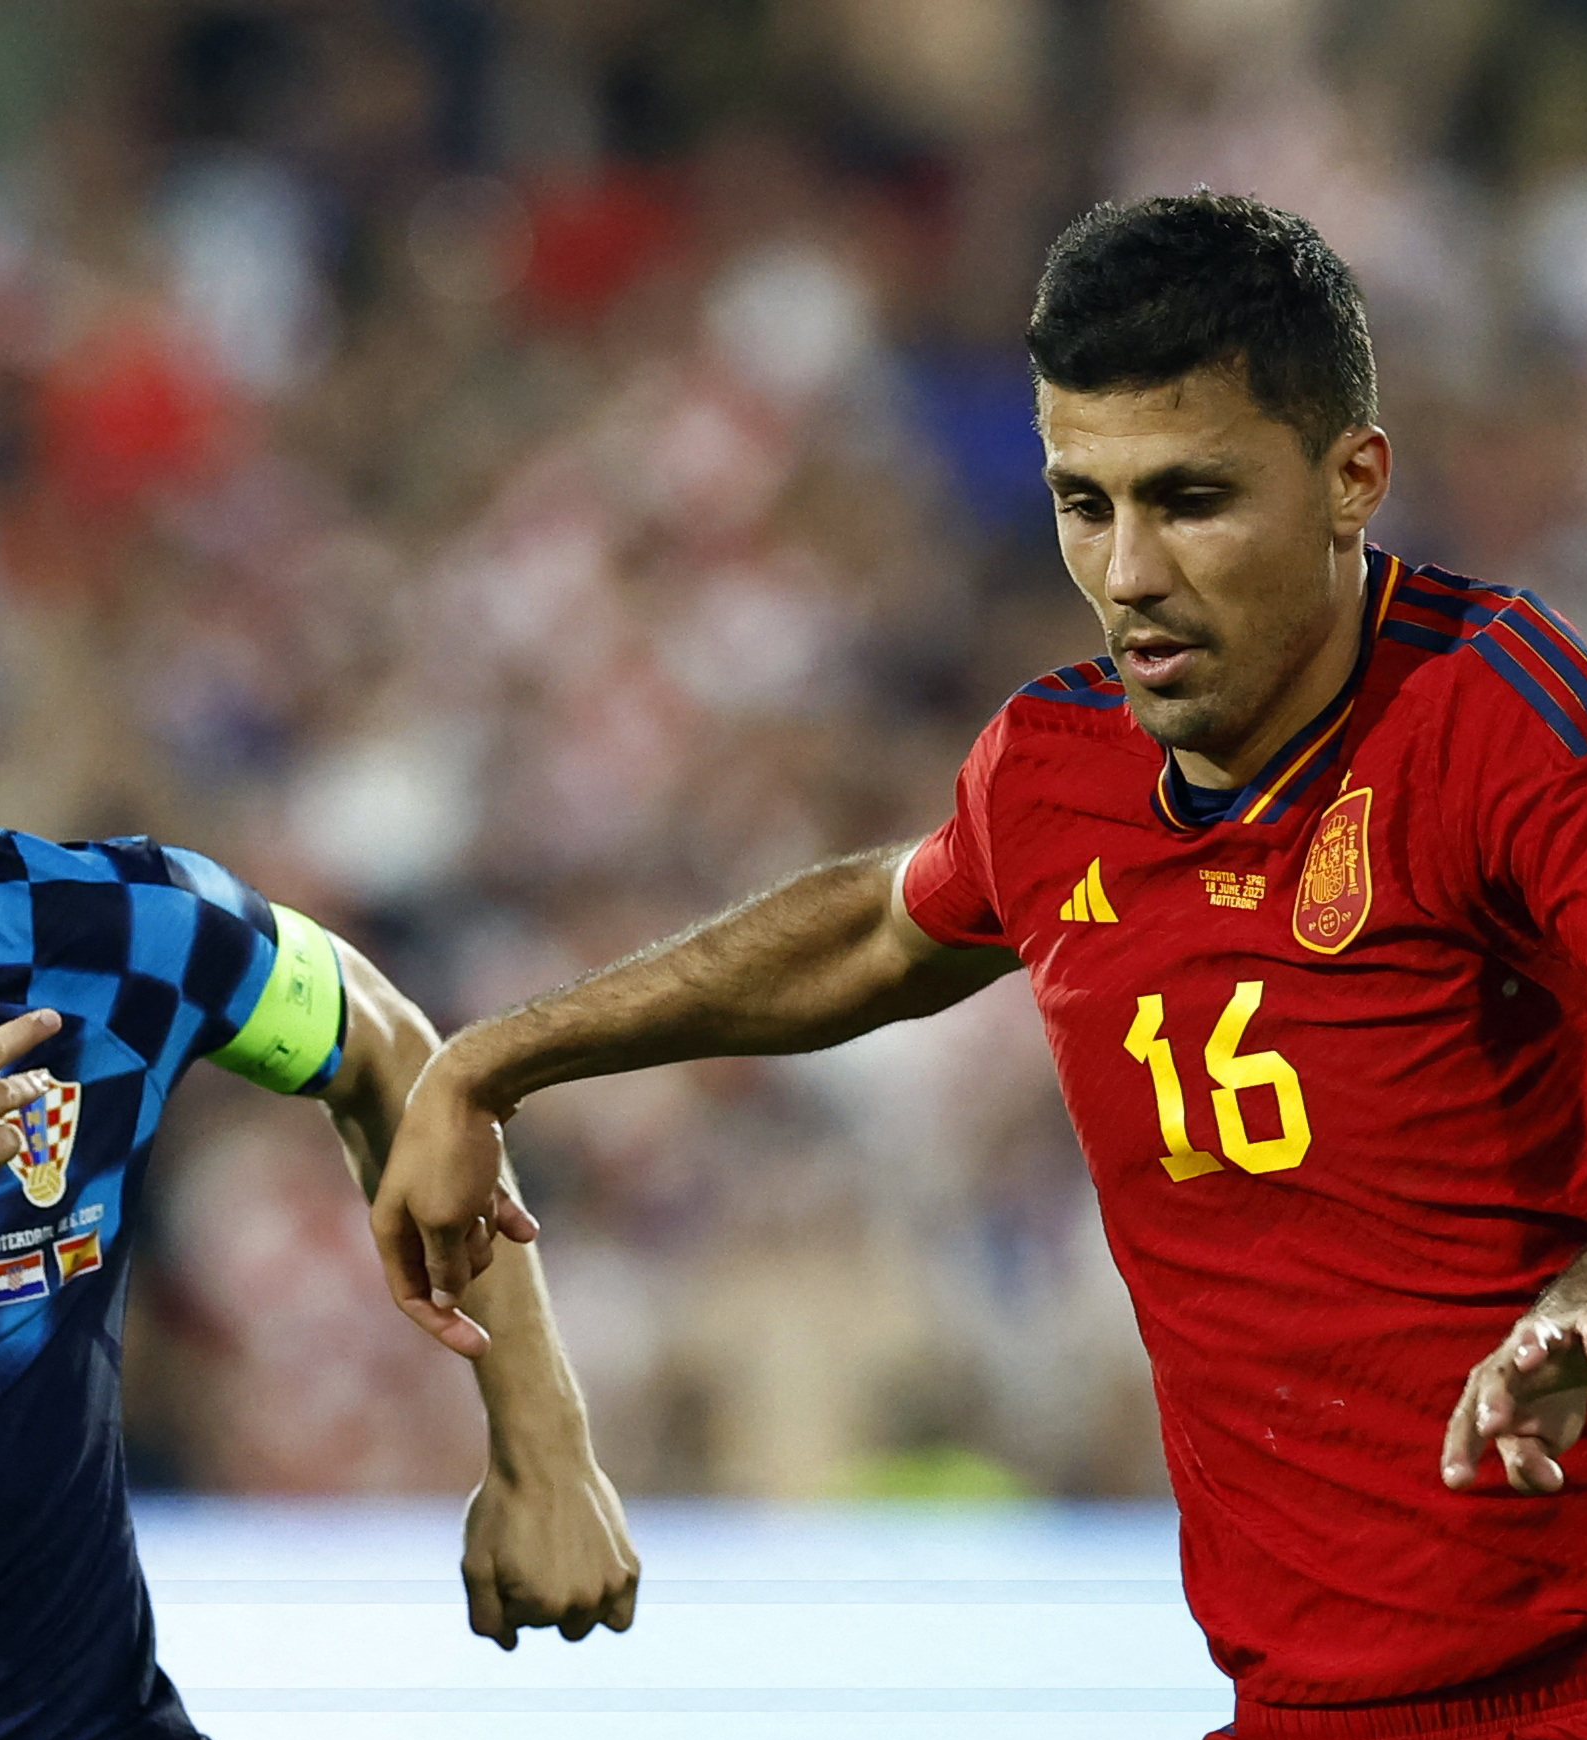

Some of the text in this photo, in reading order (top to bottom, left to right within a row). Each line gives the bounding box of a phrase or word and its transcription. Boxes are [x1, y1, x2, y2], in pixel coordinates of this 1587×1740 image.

[1199, 869, 1237, 884] CROATIA
[1246, 874, 1266, 887] SPAI
[1205, 881, 1265, 900] 18 JUNE 2023
[1209, 893, 1258, 911] ROTTERDAM
[1122, 979, 1313, 1184] 16
